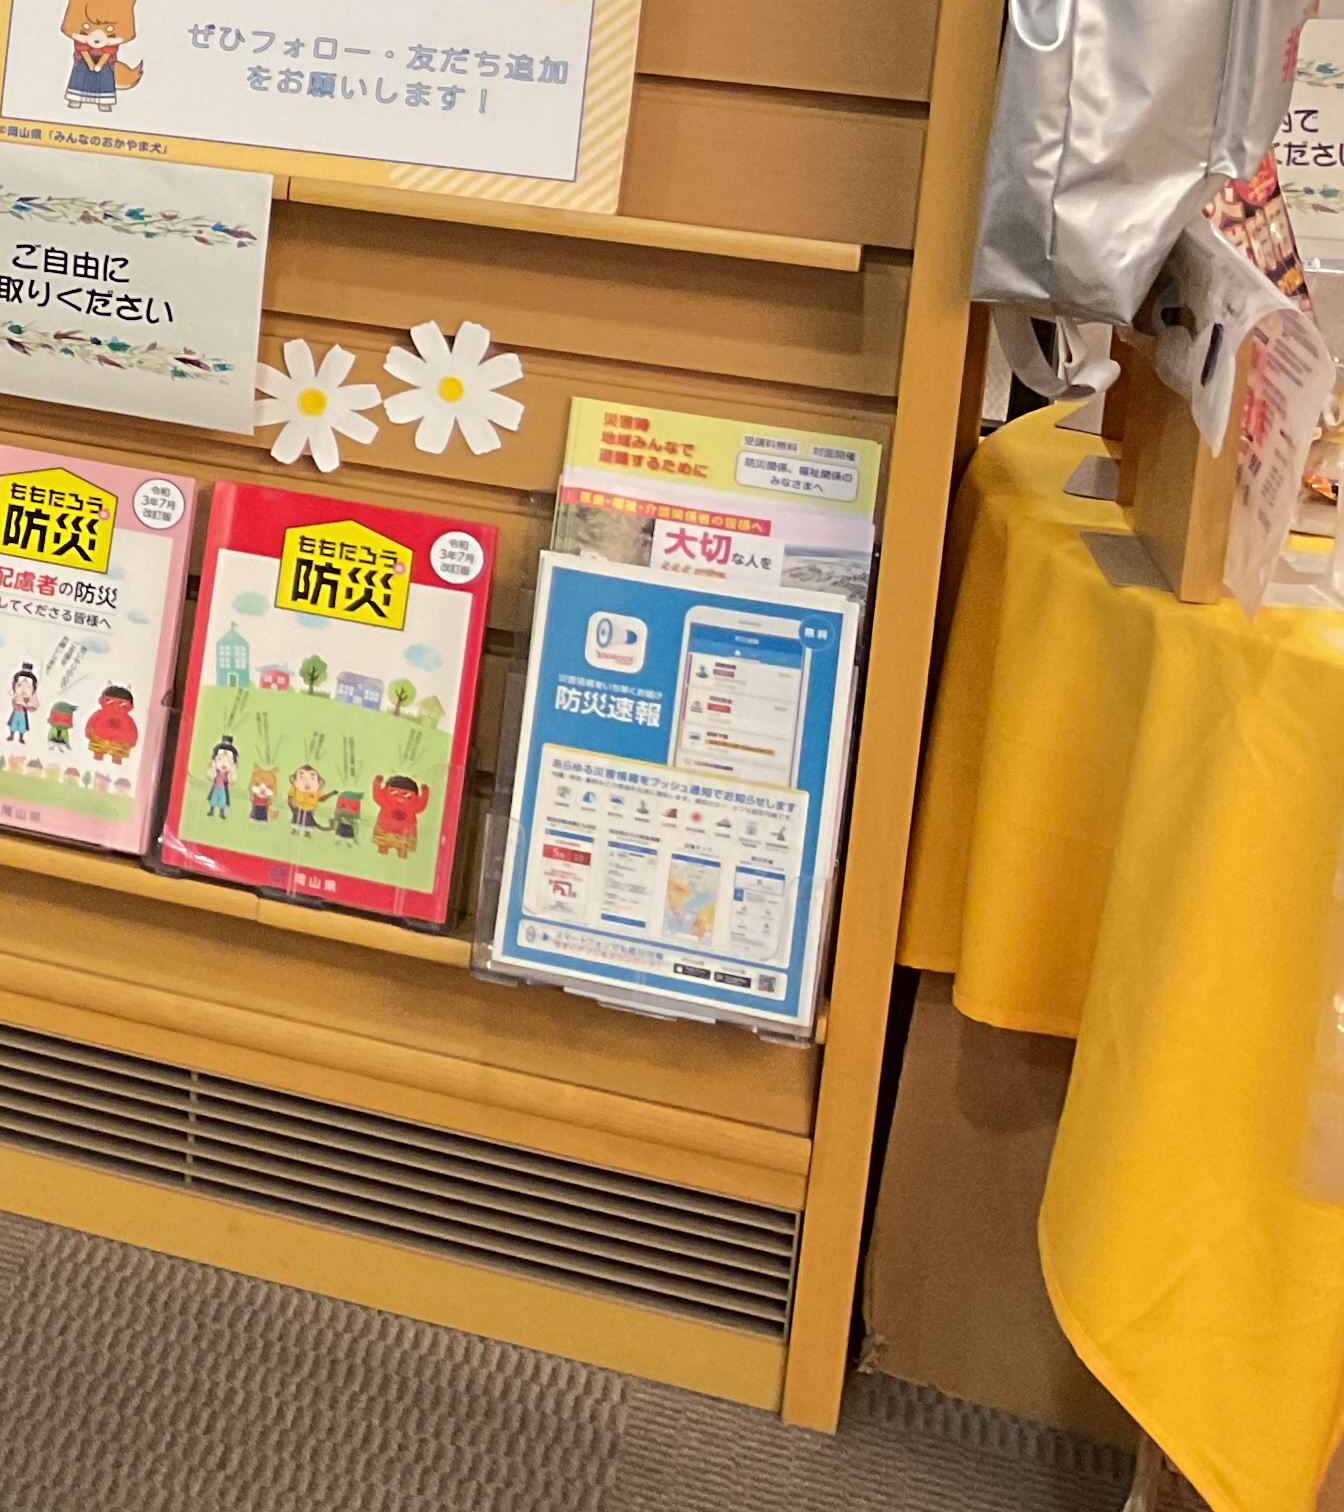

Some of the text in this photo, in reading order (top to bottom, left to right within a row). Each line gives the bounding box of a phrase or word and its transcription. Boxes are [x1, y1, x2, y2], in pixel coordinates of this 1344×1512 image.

[187, 21, 569, 86] ぜひフォロー・友だち追加
[244, 63, 493, 115] をお願いします！
[11, 242, 131, 283] ご自由に
[8, 481, 106, 516] ももたろう
[769, 474, 825, 494] みなさまへ
[1, 504, 101, 563] 防災
[298, 534, 400, 568] ももたろう
[663, 527, 773, 572] 大切な人を
[289, 557, 393, 620] 防災
[554, 684, 662, 728] 防災速報
